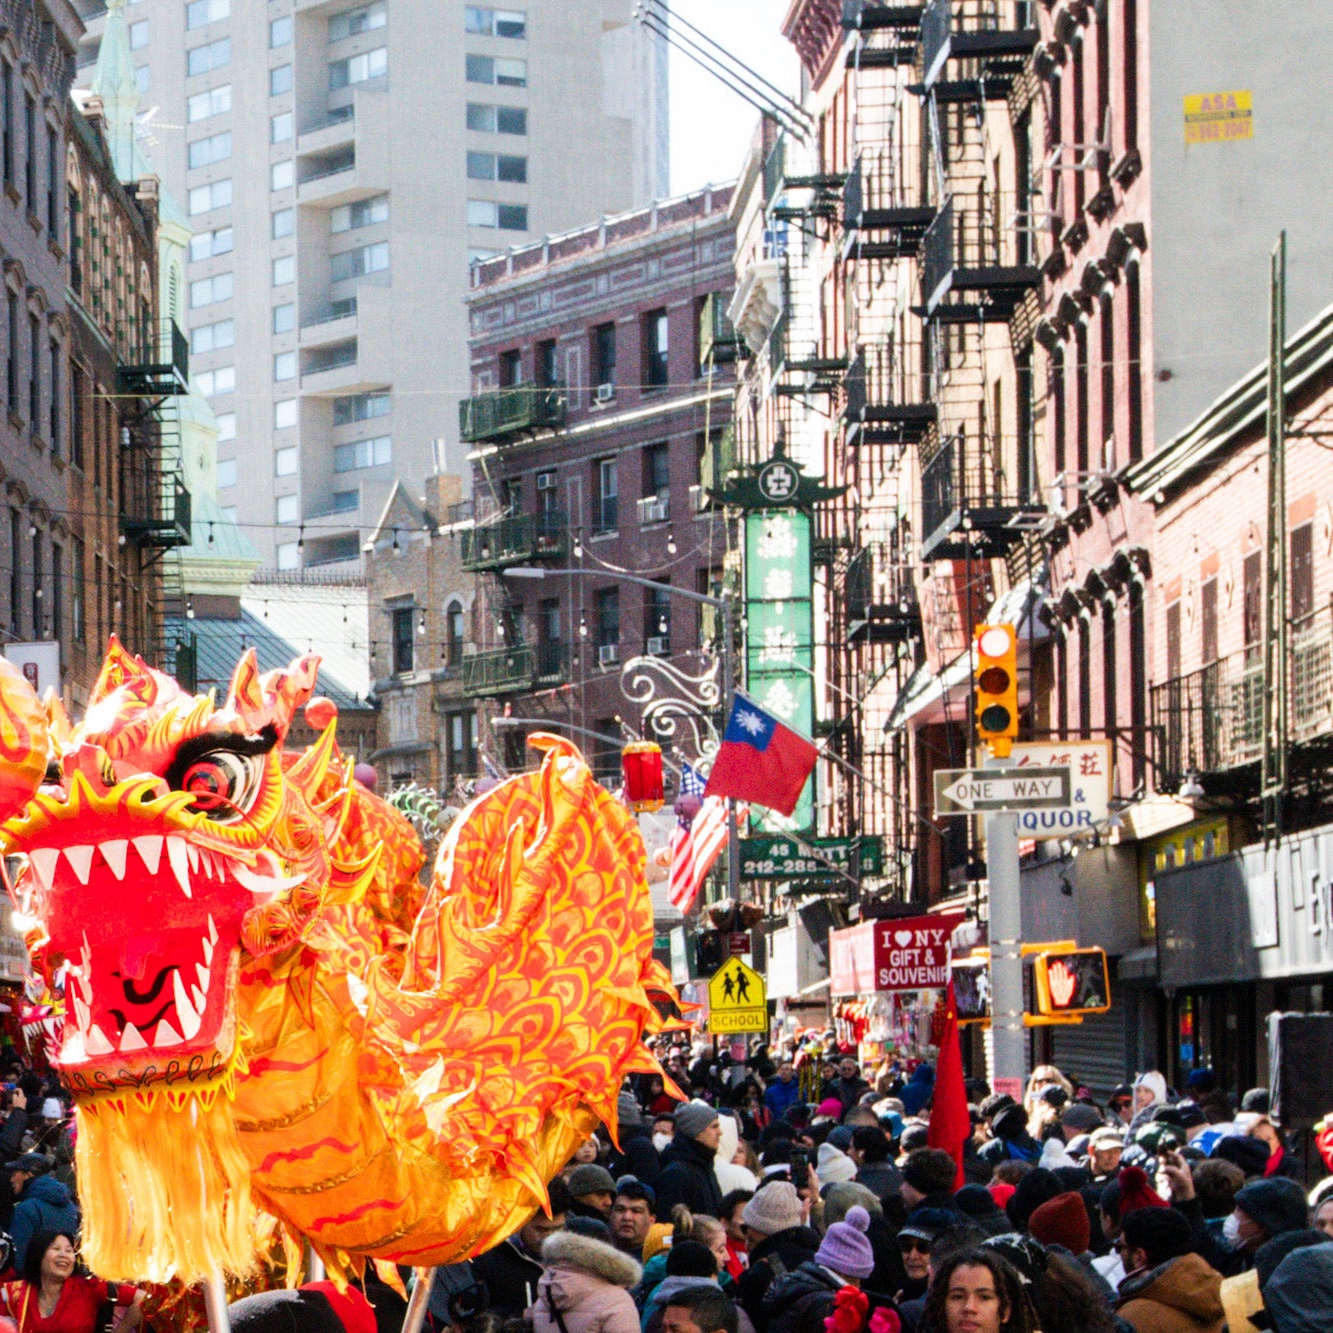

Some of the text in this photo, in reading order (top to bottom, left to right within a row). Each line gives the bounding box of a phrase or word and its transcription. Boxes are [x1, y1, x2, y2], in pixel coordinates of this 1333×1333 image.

[956, 780, 1053, 799] ONE WAY
[1075, 788, 1086, 802] &
[769, 844, 789, 856] 45
[915, 929, 945, 947] NY
[890, 948, 935, 966] GIFT &
[713, 1015, 763, 1027] SCHOOL
